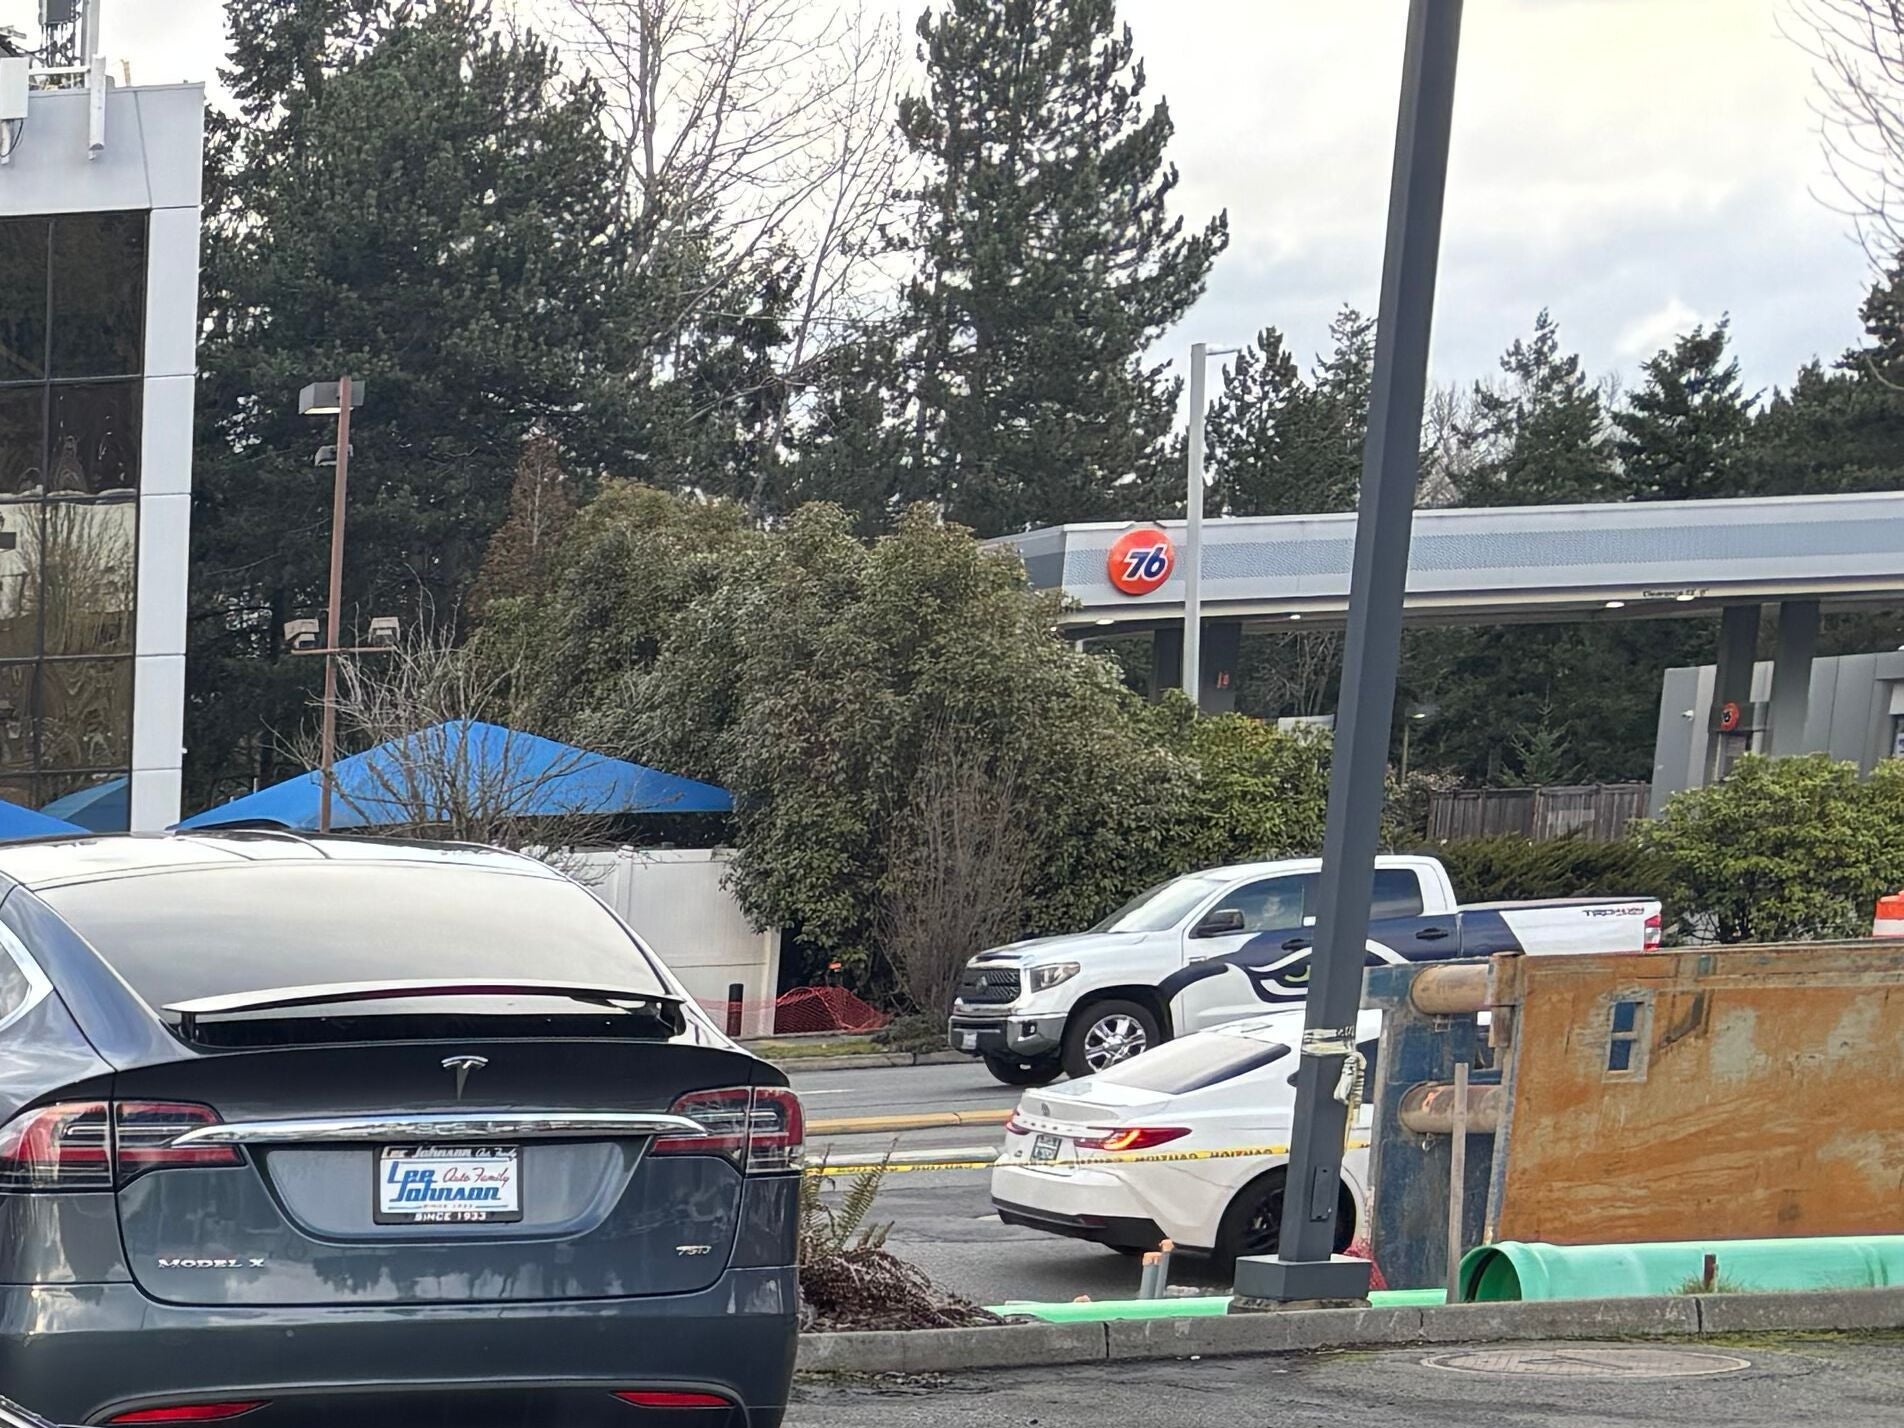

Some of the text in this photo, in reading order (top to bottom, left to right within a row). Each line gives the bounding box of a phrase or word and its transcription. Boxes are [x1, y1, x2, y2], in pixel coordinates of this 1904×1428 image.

[1121, 543, 1168, 582] 76
[411, 1145, 472, 1158] Johnson
[387, 1160, 510, 1188] Lee Auto Family
[389, 1176, 502, 1203] Johnson
[414, 1211, 487, 1222] SINCE 1933
[158, 1258, 265, 1268] MODEL X
